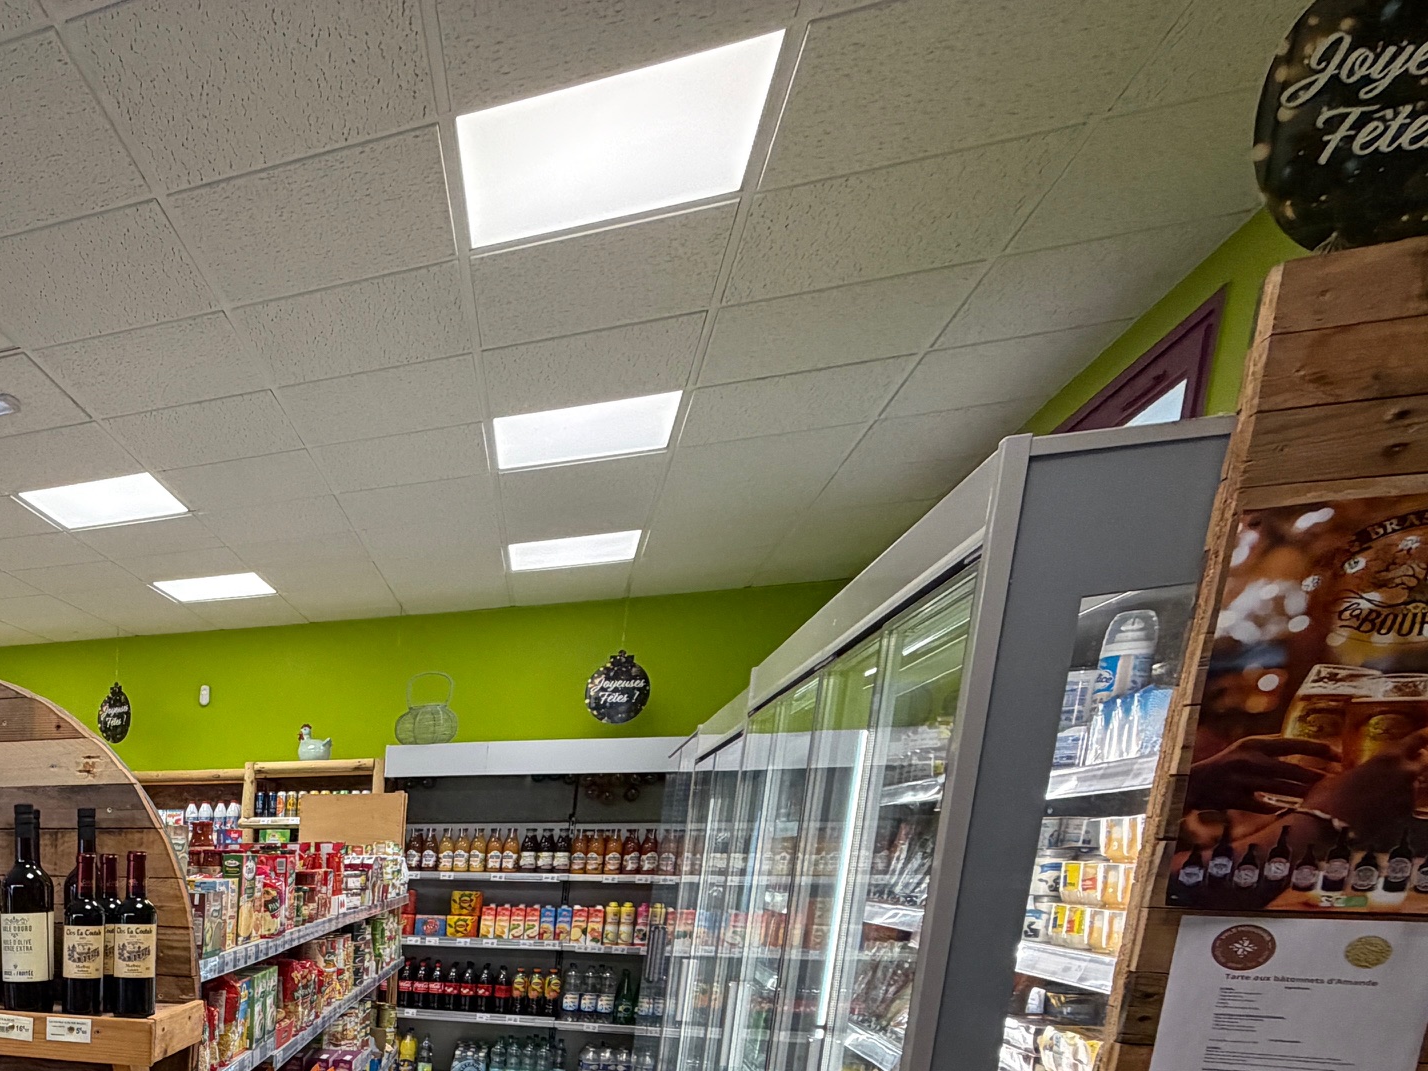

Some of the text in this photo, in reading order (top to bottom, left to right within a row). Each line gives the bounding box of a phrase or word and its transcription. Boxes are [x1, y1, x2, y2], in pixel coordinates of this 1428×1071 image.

[590, 674, 646, 692] Joyeuses
[599, 690, 640, 704] Fêtes !
[1225, 973, 1251, 981] Tarte
